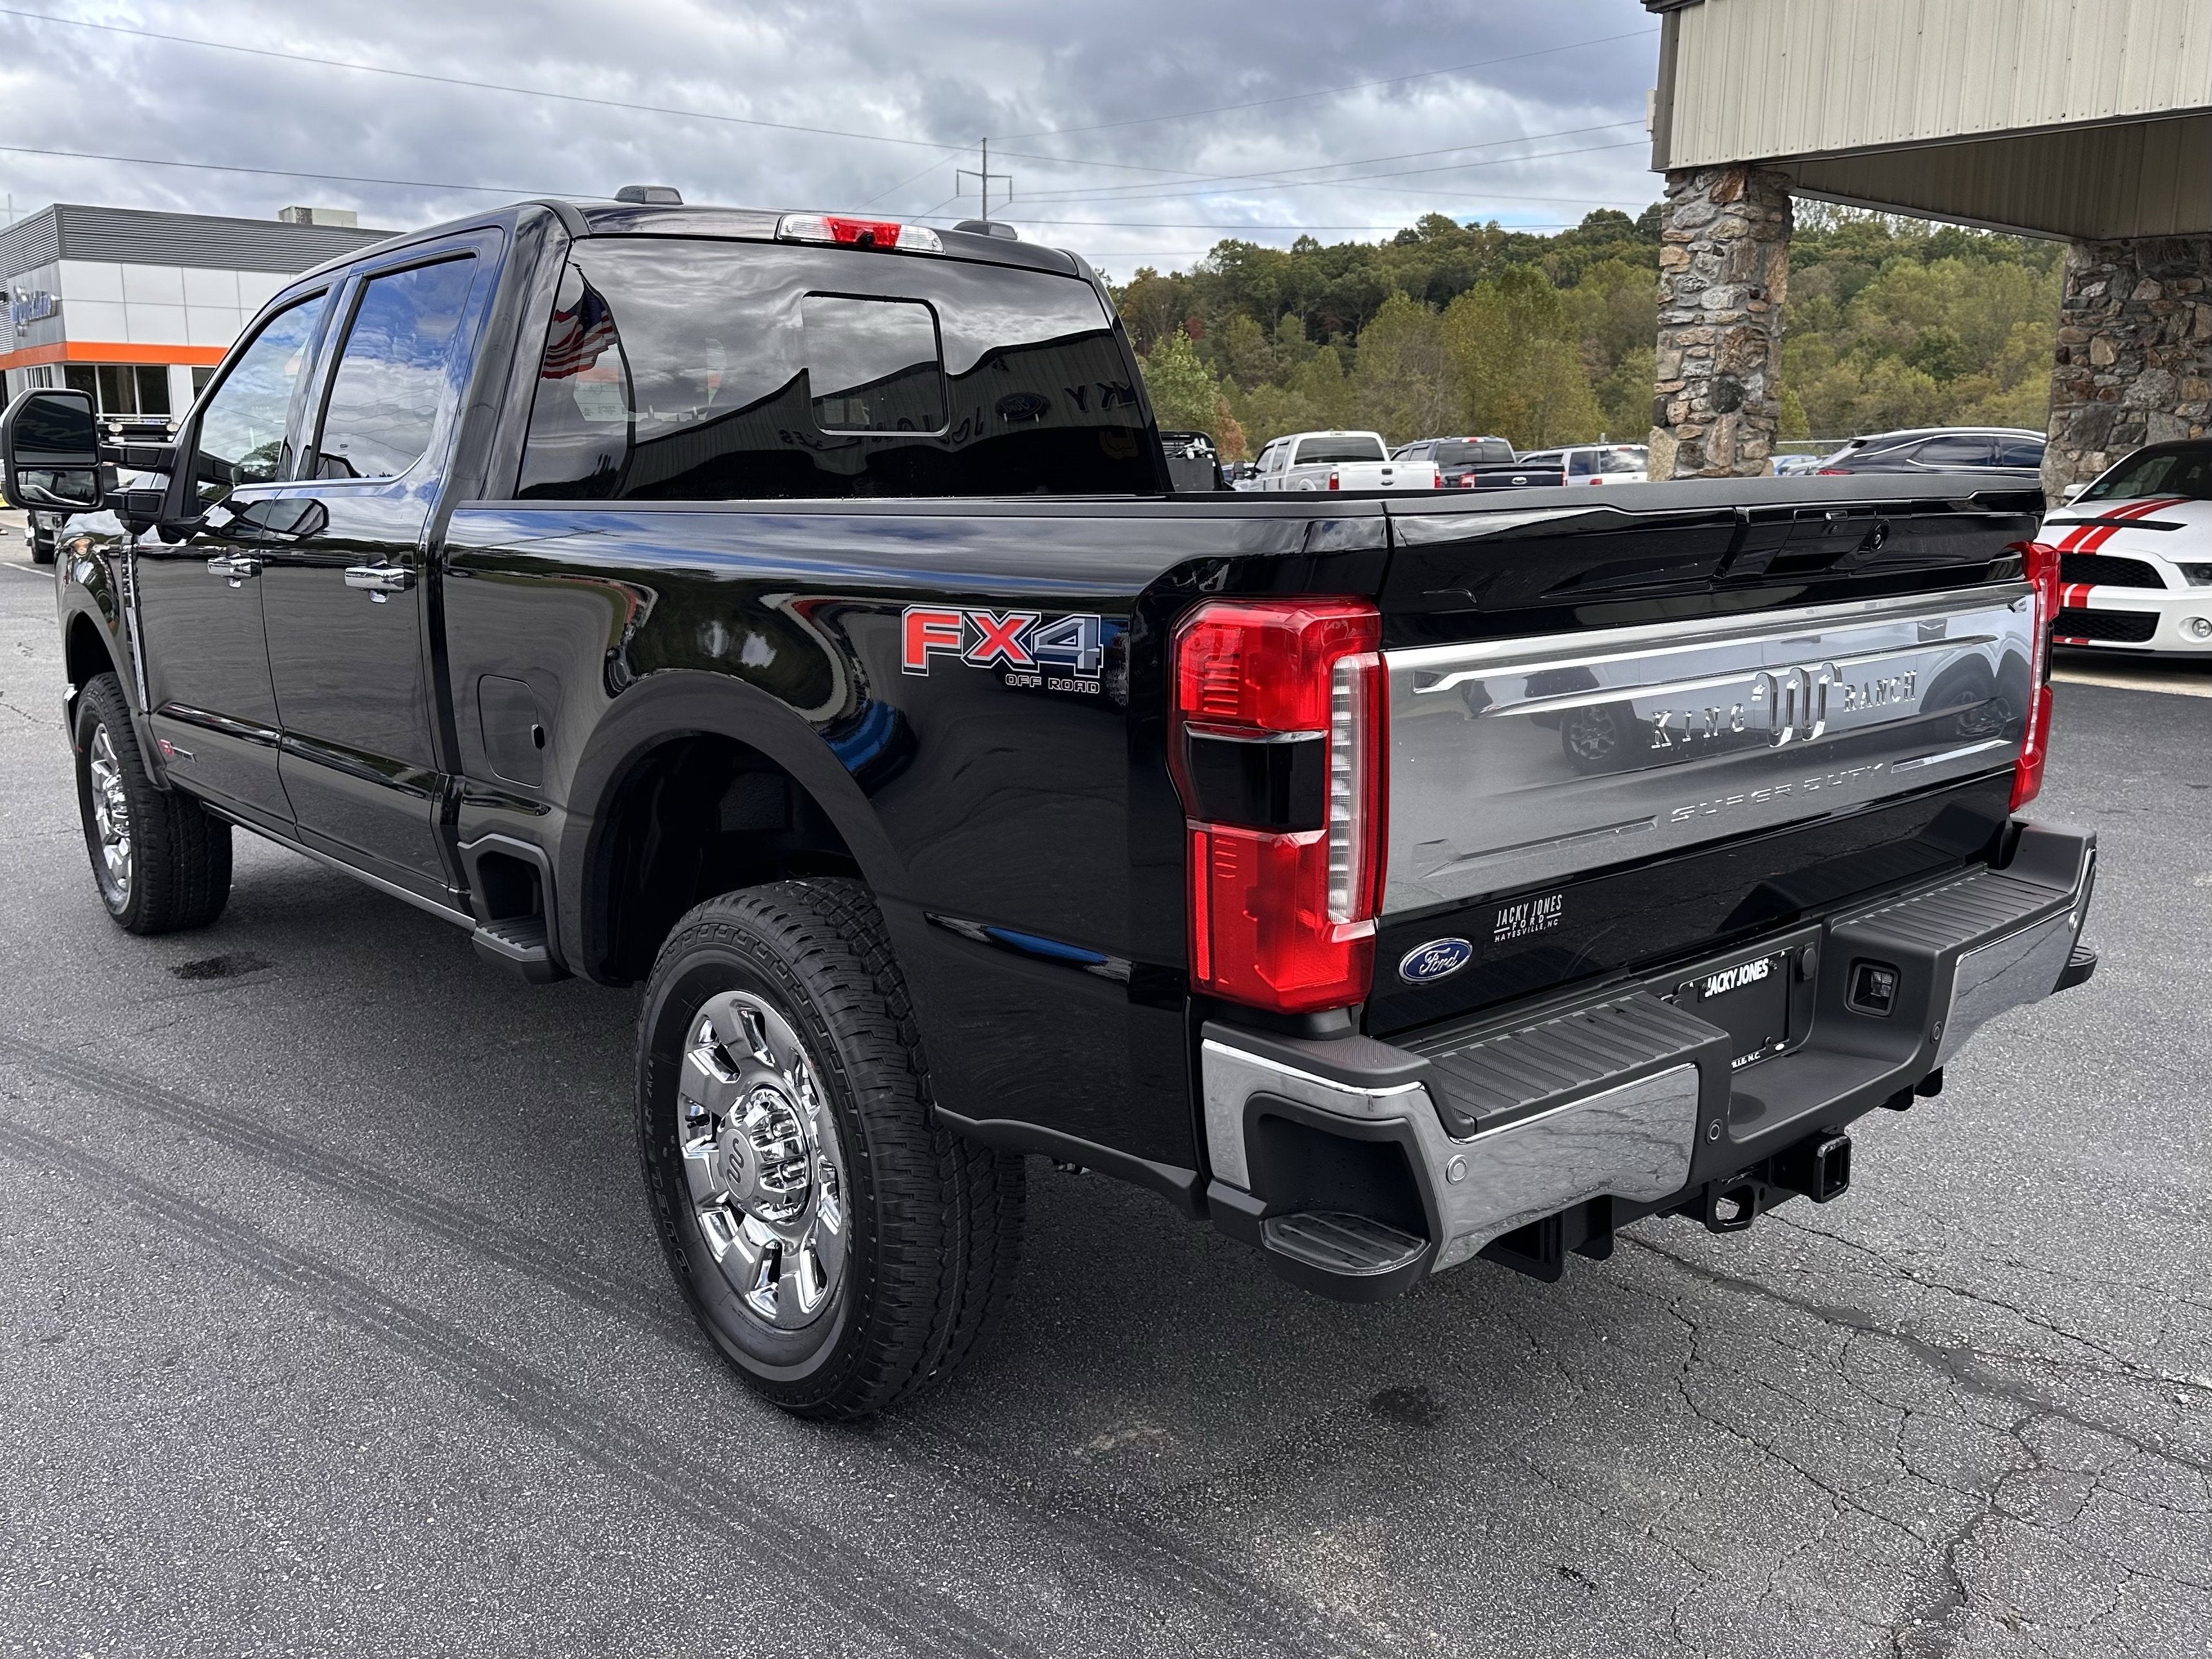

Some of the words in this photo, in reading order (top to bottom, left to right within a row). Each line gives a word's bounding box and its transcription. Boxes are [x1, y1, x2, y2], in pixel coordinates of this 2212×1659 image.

[902, 604, 1103, 678] FX4
[1005, 674, 1042, 688] OFF
[1048, 678, 1100, 694] ROAD
[1650, 702, 1744, 749] KING
[1842, 669, 1918, 713] RANCH
[1670, 784, 1795, 822] SUPER
[1802, 763, 1884, 799] DUTY
[1496, 902, 1529, 927] JACKY
[1531, 894, 1562, 917] JONES
[1512, 915, 1544, 931] FORD
[1419, 947, 1460, 975] Ford
[1705, 968, 1738, 998] JACKY
[1736, 958, 1769, 987] JONES
